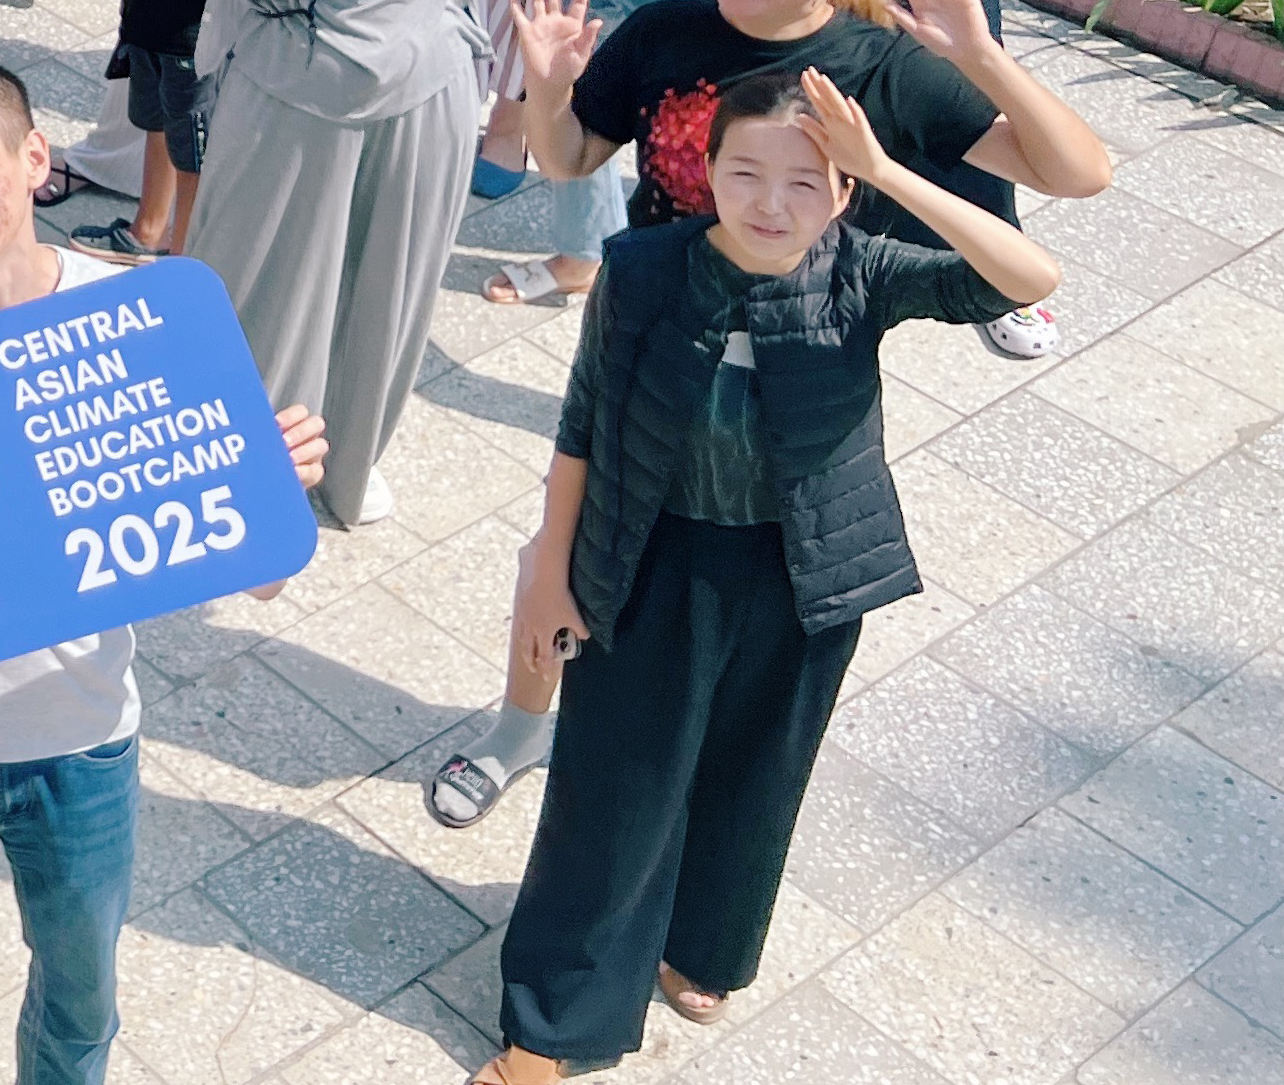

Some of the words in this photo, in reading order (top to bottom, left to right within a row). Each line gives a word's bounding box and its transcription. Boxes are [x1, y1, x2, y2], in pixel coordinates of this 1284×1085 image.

[14, 349, 129, 411] ASIAN
[23, 376, 172, 444] CLIMATE
[34, 398, 231, 483] EDUCATION
[47, 433, 246, 517] BOOTCAMP
[64, 485, 247, 593] 2025
